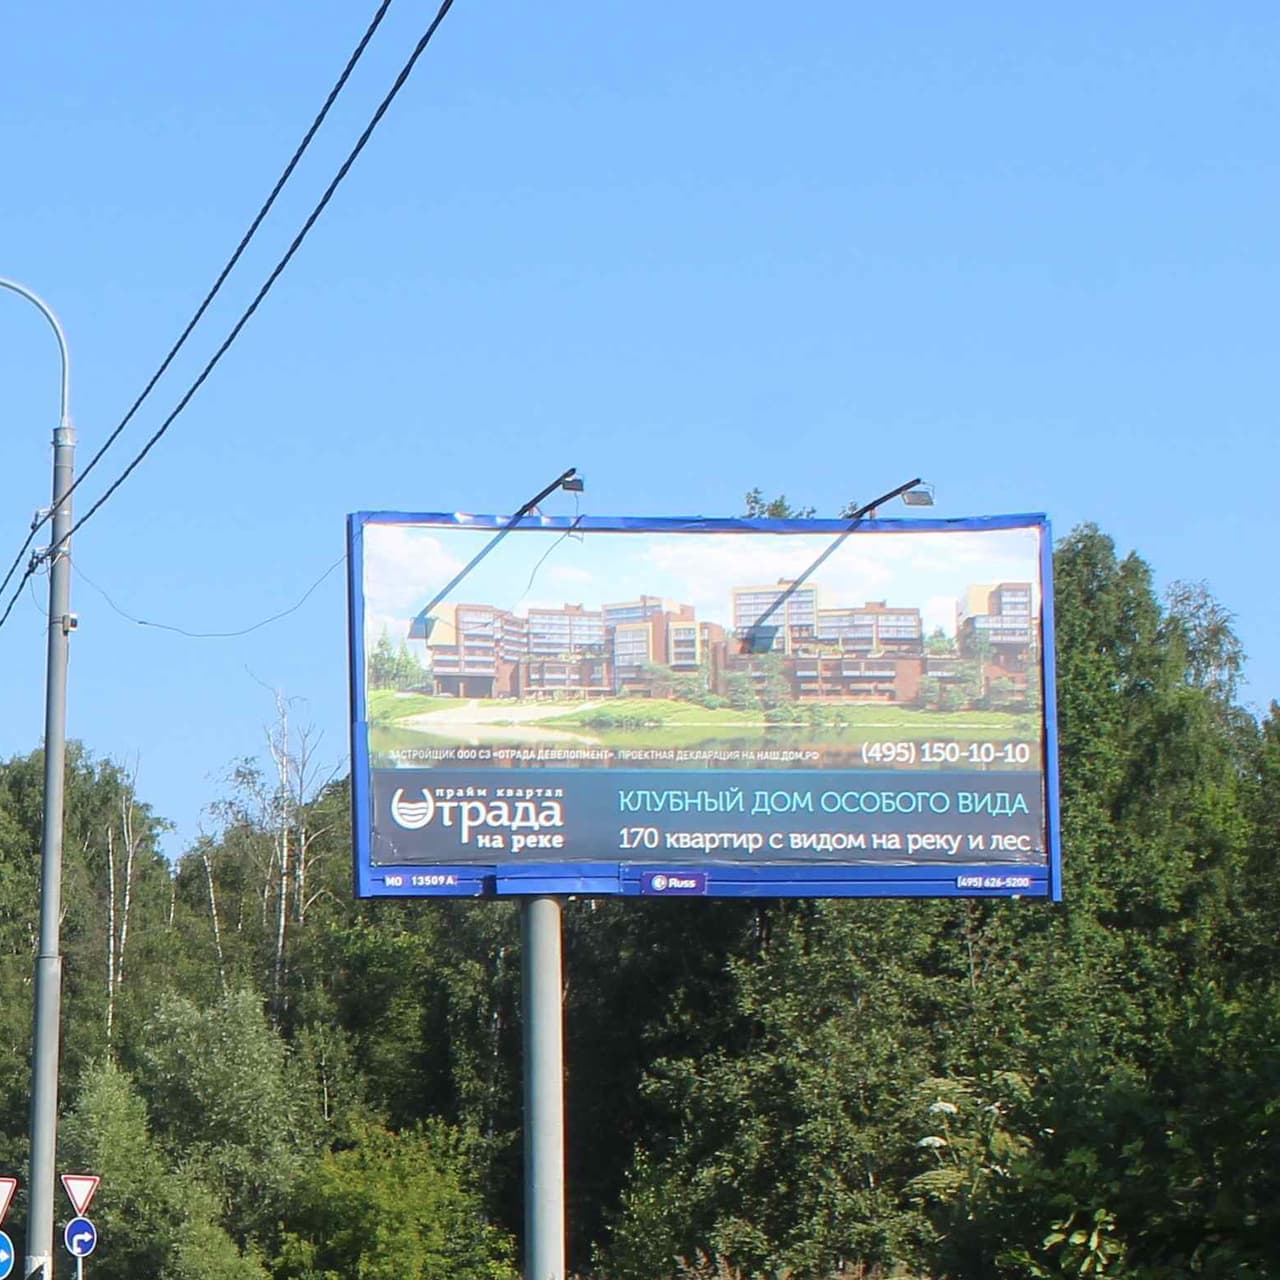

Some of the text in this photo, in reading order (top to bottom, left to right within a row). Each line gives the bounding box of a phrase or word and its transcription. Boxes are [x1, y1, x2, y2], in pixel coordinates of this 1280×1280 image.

[457, 750, 476, 760] ООО
[618, 750, 674, 761] ПРОЕКТНАЯ
[676, 750, 739, 761] ДЕКЛАРАЦИЯ
[742, 750, 755, 761] НА
[862, 742, 1030, 763] (495) 150-10-10
[435, 787, 563, 799] прайм квартал
[618, 787, 1029, 816] КЛУБНЫЙ ДОМ ОСОБОГО ВИДА
[477, 834, 564, 852] на реке
[619, 827, 1031, 854] 170 квартир с видом на реку и лес
[668, 878, 696, 888] Russ
[984, 877, 1030, 887] 626-5200
